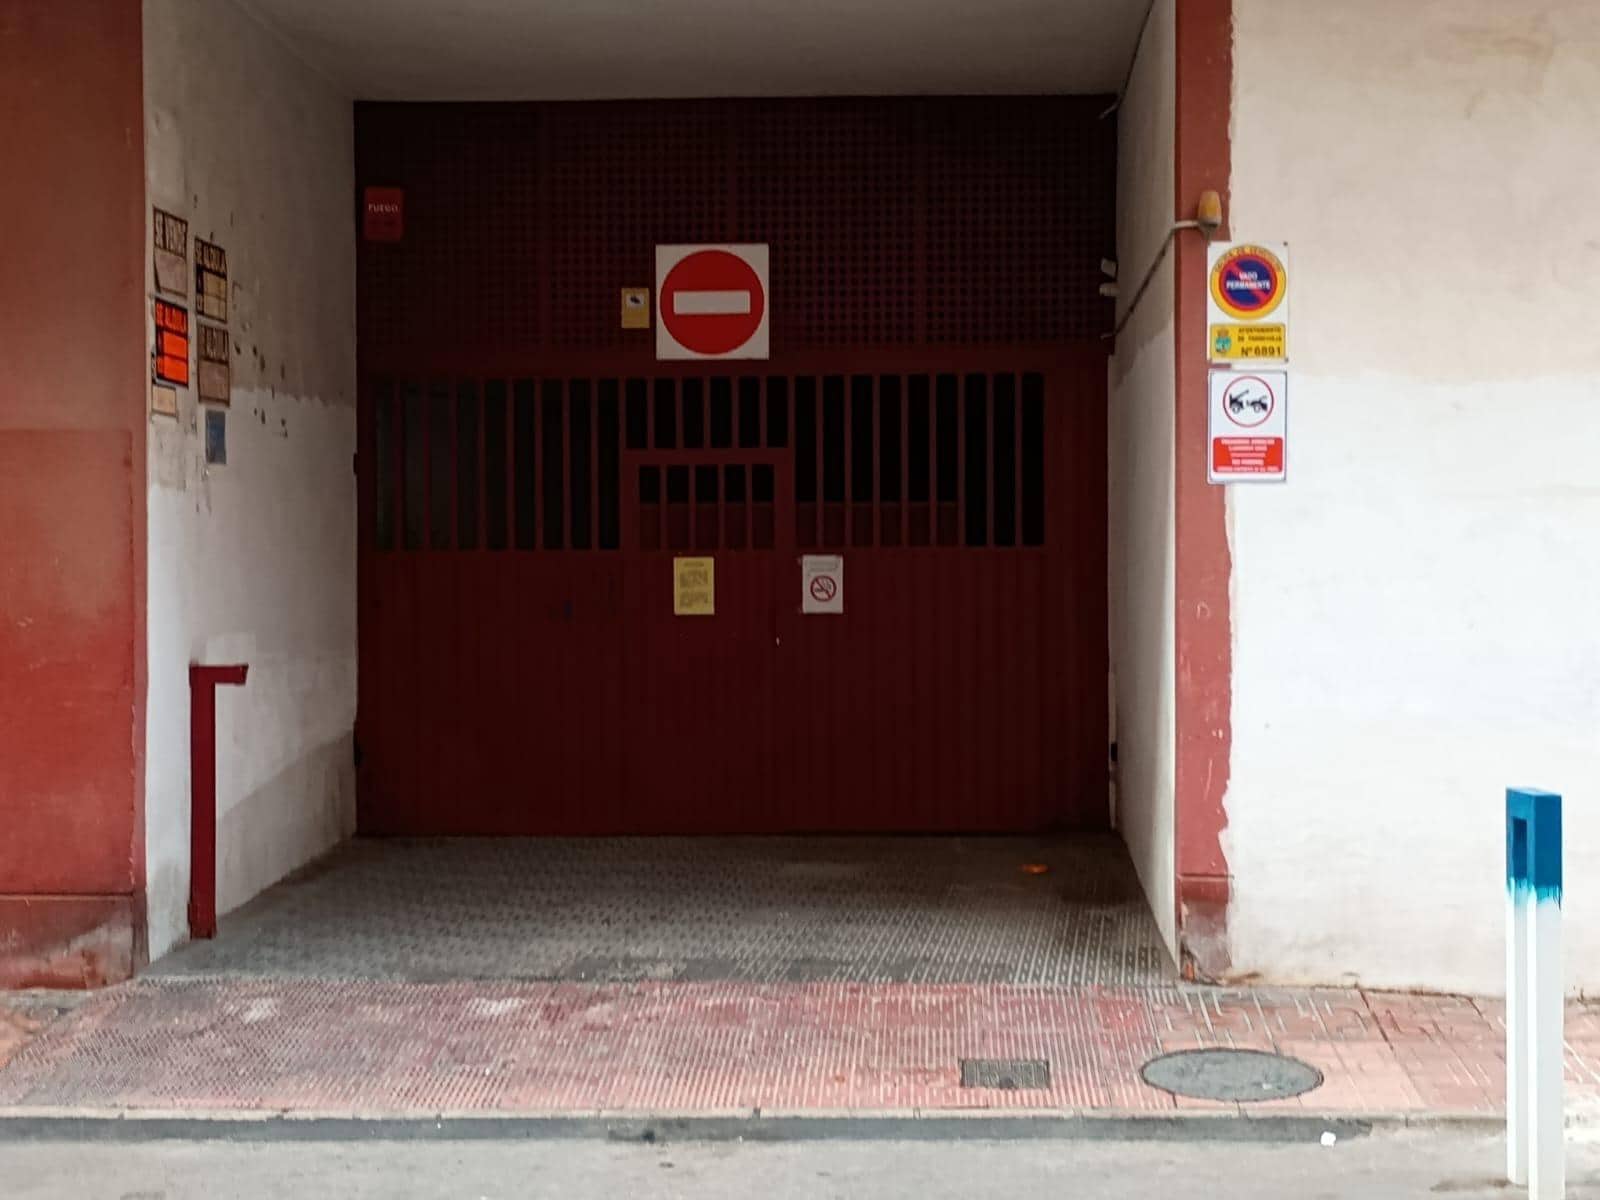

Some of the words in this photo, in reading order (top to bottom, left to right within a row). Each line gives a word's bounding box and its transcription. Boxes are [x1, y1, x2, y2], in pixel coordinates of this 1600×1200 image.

[368, 203, 399, 213] FUEGO
[1238, 271, 1258, 280] VADO
[1226, 281, 1271, 290] PERMANENTE
